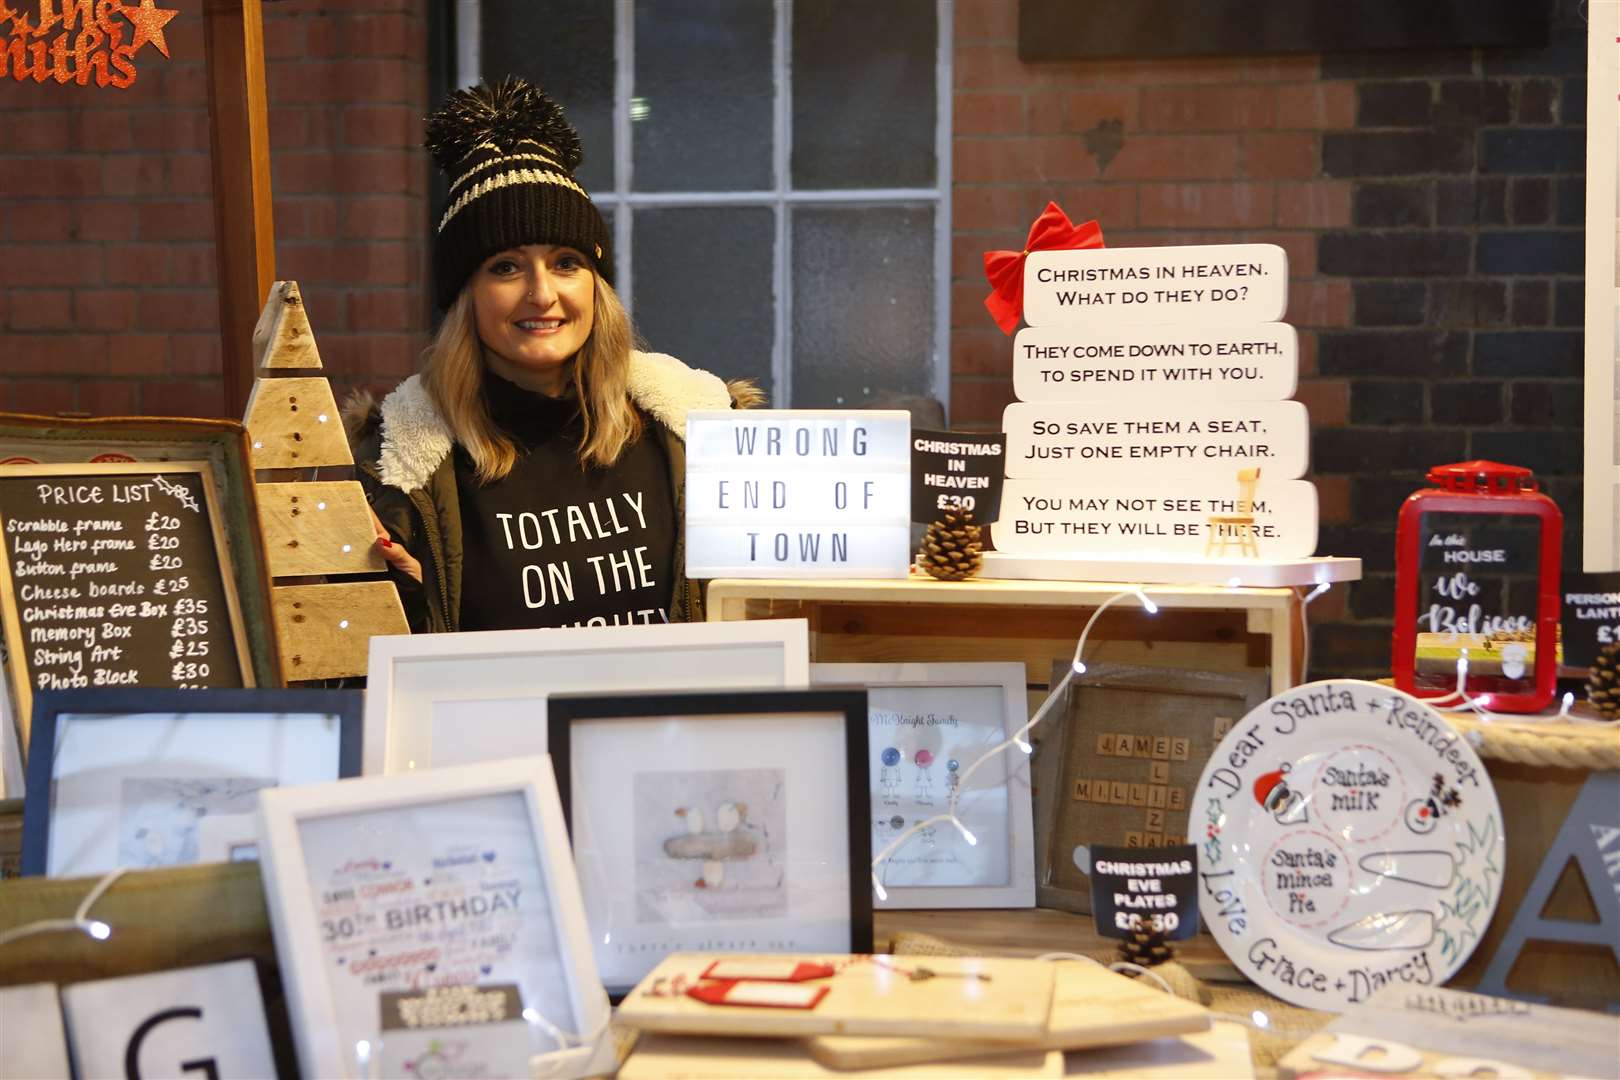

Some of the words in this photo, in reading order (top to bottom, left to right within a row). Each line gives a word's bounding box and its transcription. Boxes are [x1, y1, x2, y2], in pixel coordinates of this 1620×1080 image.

[1037, 267, 1151, 283] CHRISTMAS
[1156, 266, 1175, 279] IN
[1182, 263, 1268, 278] HEAVEN.
[1056, 291, 1116, 306] WHAT
[1122, 291, 1148, 304] DO
[1154, 289, 1206, 303] THEY
[1211, 286, 1249, 302] DO?
[1023, 345, 1070, 360] THEY
[1073, 345, 1125, 358] COME
[1129, 344, 1184, 357] DOWN
[1188, 343, 1213, 356] TO
[1041, 370, 1065, 382] TO
[1070, 369, 1135, 382] SPEND
[1141, 369, 1157, 381] IT
[1162, 368, 1212, 380] WITH
[1219, 367, 1263, 380] YOU.
[1033, 421, 1060, 435] SO
[1066, 422, 1118, 435] SAVE
[1124, 421, 1180, 434] THEM
[1187, 421, 1201, 433] A
[735, 426, 868, 457] WRONG
[913, 439, 1002, 456] CHRISTMAS
[1025, 445, 1075, 459] JUST
[1080, 446, 1123, 458] ONE
[1130, 445, 1197, 458] EMPTY
[1203, 445, 1275, 458] CHAIR.
[947, 459, 966, 472] IN
[924, 473, 989, 489] HEAVEN
[37, 484, 104, 505] PRICE
[113, 484, 154, 503] LIST
[718, 480, 787, 510] END
[834, 480, 875, 510] OF
[937, 495, 976, 512] £30
[1023, 496, 1062, 511] YOU
[1069, 498, 1109, 511] MAY
[1116, 499, 1156, 511] NOT
[1163, 500, 1201, 512] SEE
[6, 518, 69, 533] Scrabble
[73, 518, 122, 536] frame
[145, 512, 181, 532] £20
[496, 491, 647, 550] TOTALLY
[1015, 520, 1055, 535] BUT
[1060, 522, 1111, 535] THEY
[1118, 523, 1167, 536] WILL
[1174, 523, 1200, 536] BE
[14, 536, 48, 561] Lego
[53, 537, 87, 553] Hero
[91, 538, 136, 555] frame
[148, 533, 180, 550] £20
[746, 532, 848, 562] TOWN
[1443, 549, 1507, 562] HOUSE
[15, 562, 66, 577] Button
[69, 561, 118, 579] frame
[149, 554, 183, 571] £20
[521, 561, 575, 609] ON
[586, 546, 656, 595] THE
[21, 584, 81, 602] Cheese
[89, 580, 145, 597] boards
[152, 577, 189, 596] £25
[23, 606, 104, 623] Christmas
[139, 601, 168, 617] Box
[173, 598, 208, 616] £35
[1576, 607, 1620, 619] LANT
[102, 623, 132, 639] Box
[170, 617, 208, 638] £35
[34, 648, 83, 674] String
[91, 646, 122, 662] Art
[169, 638, 210, 660] £25
[37, 671, 88, 690] Photo
[171, 661, 210, 681] £30
[1100, 738, 1185, 756] JAMES
[1208, 724, 1267, 800] Dear
[1270, 685, 1356, 735] Santa
[1385, 694, 1481, 788] Reindeer
[1321, 762, 1391, 789] Santa's
[1075, 783, 1183, 804] MILLIE
[1095, 860, 1193, 877] CHRISTMAS
[1270, 847, 1338, 869] Santa's
[1127, 879, 1162, 893] EVE
[384, 889, 523, 931] BIRTHDAY
[1113, 892, 1177, 909] PLATES
[1201, 869, 1248, 936] Love
[1288, 891, 1317, 914] Pie
[1248, 937, 1328, 993] Grace
